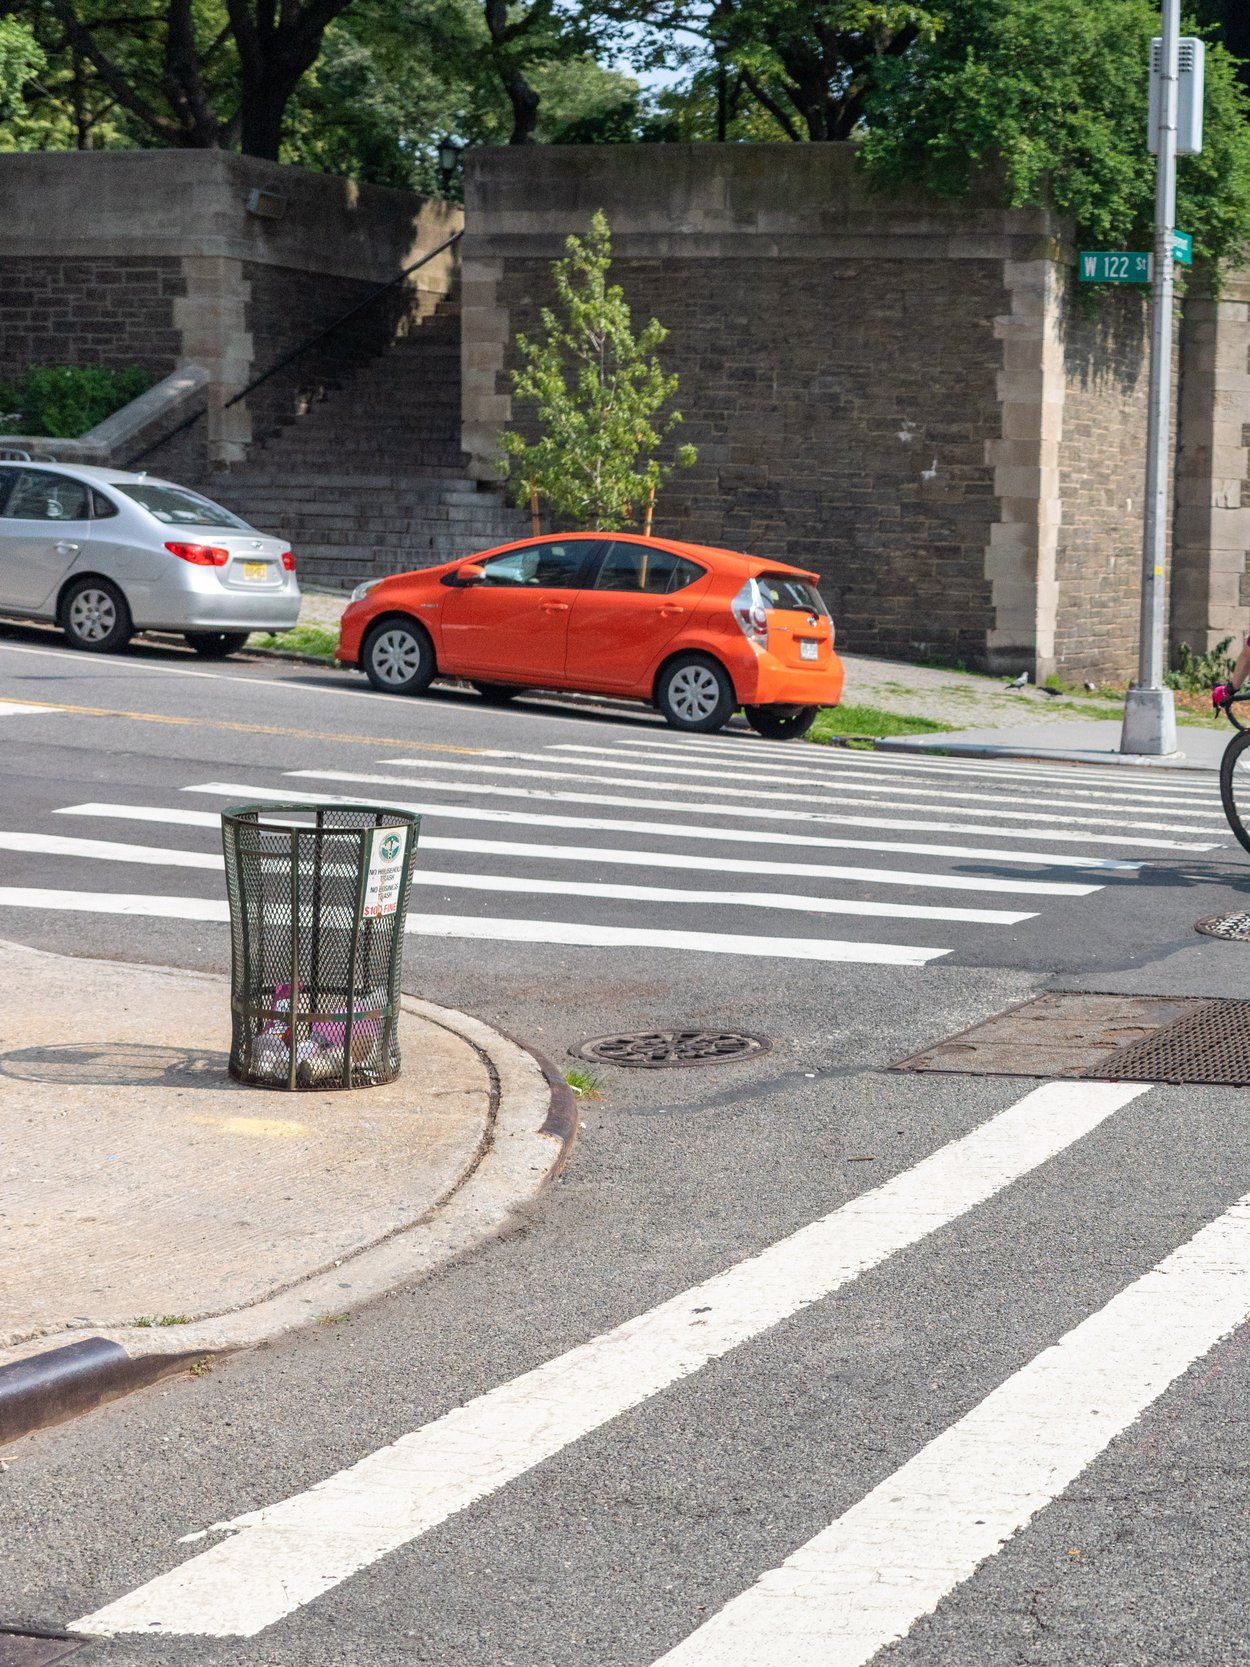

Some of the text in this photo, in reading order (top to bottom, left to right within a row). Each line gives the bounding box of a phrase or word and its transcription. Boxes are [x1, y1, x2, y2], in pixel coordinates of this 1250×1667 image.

[1084, 256, 1147, 278] W 122 St
[384, 902, 397, 913] FINE
